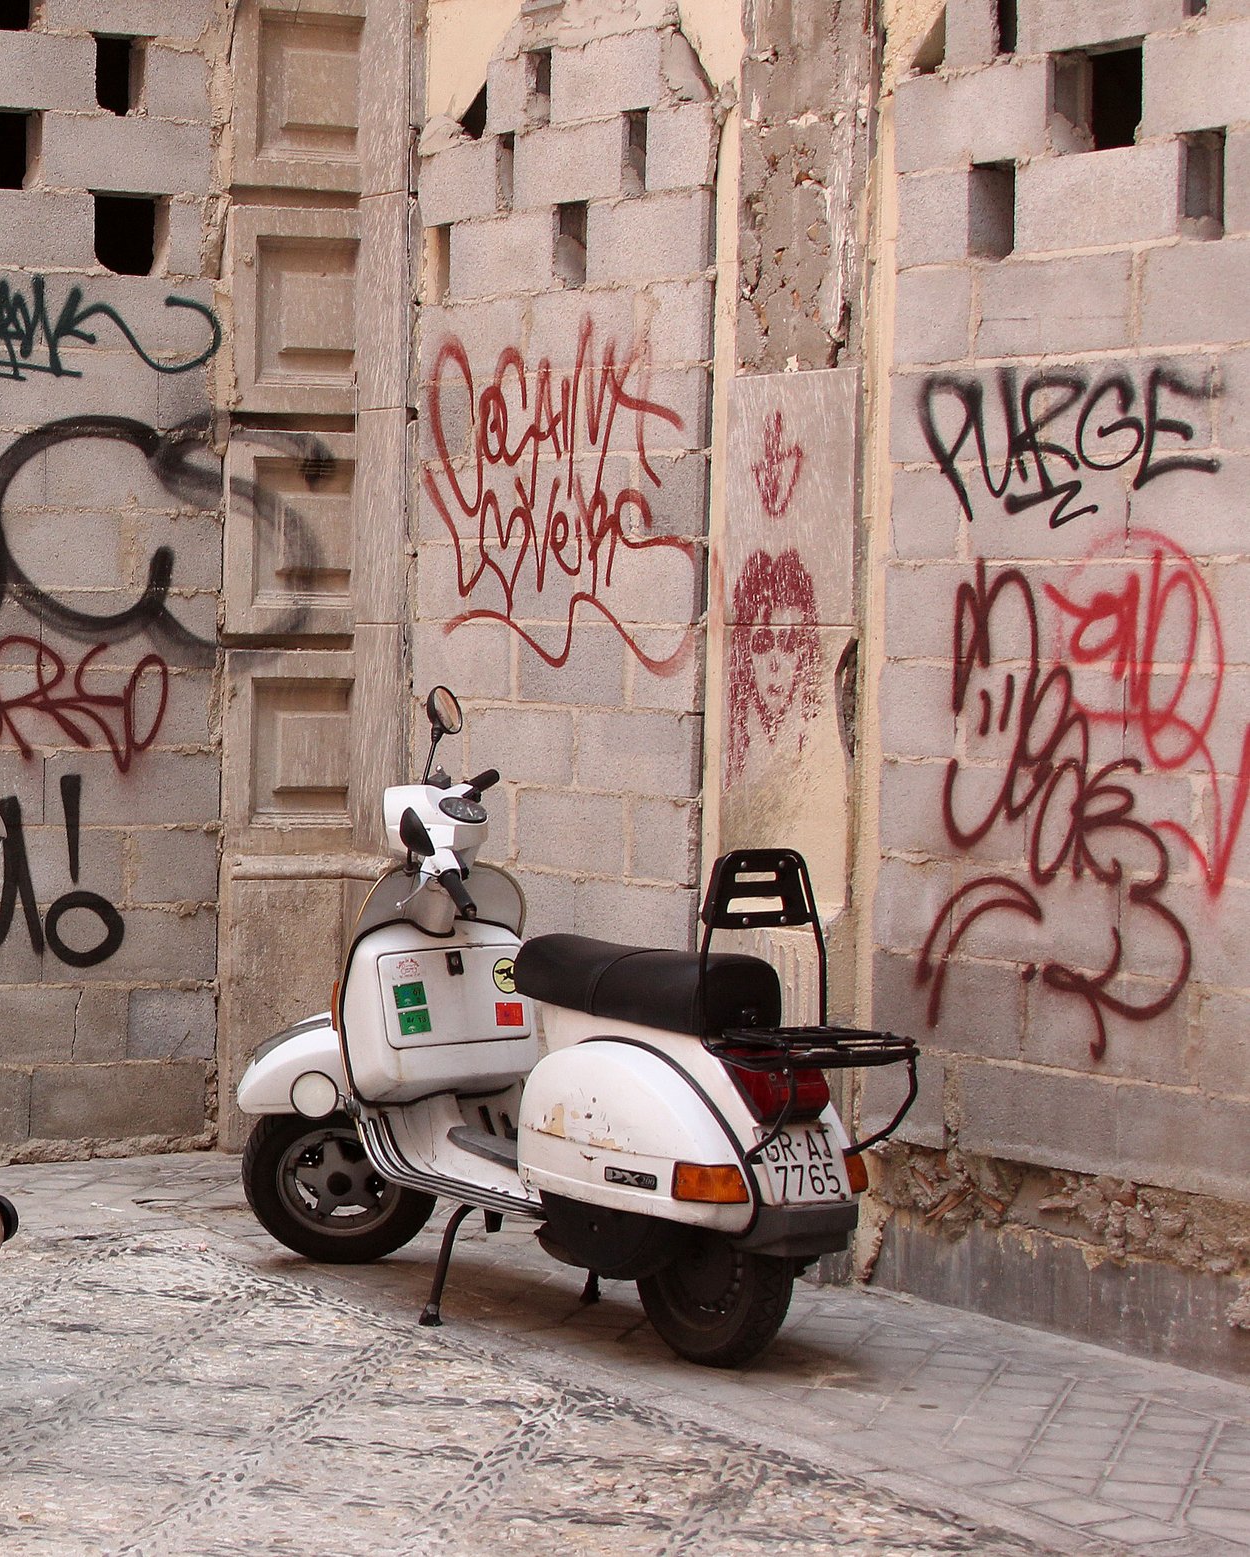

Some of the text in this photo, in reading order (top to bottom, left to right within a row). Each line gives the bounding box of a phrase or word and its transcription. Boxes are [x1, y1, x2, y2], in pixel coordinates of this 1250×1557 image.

[917, 366, 1226, 524] PURGE
[761, 1129, 833, 1162] GR-AJ
[605, 1168, 640, 1185] PX
[774, 1163, 841, 1199] 7765
